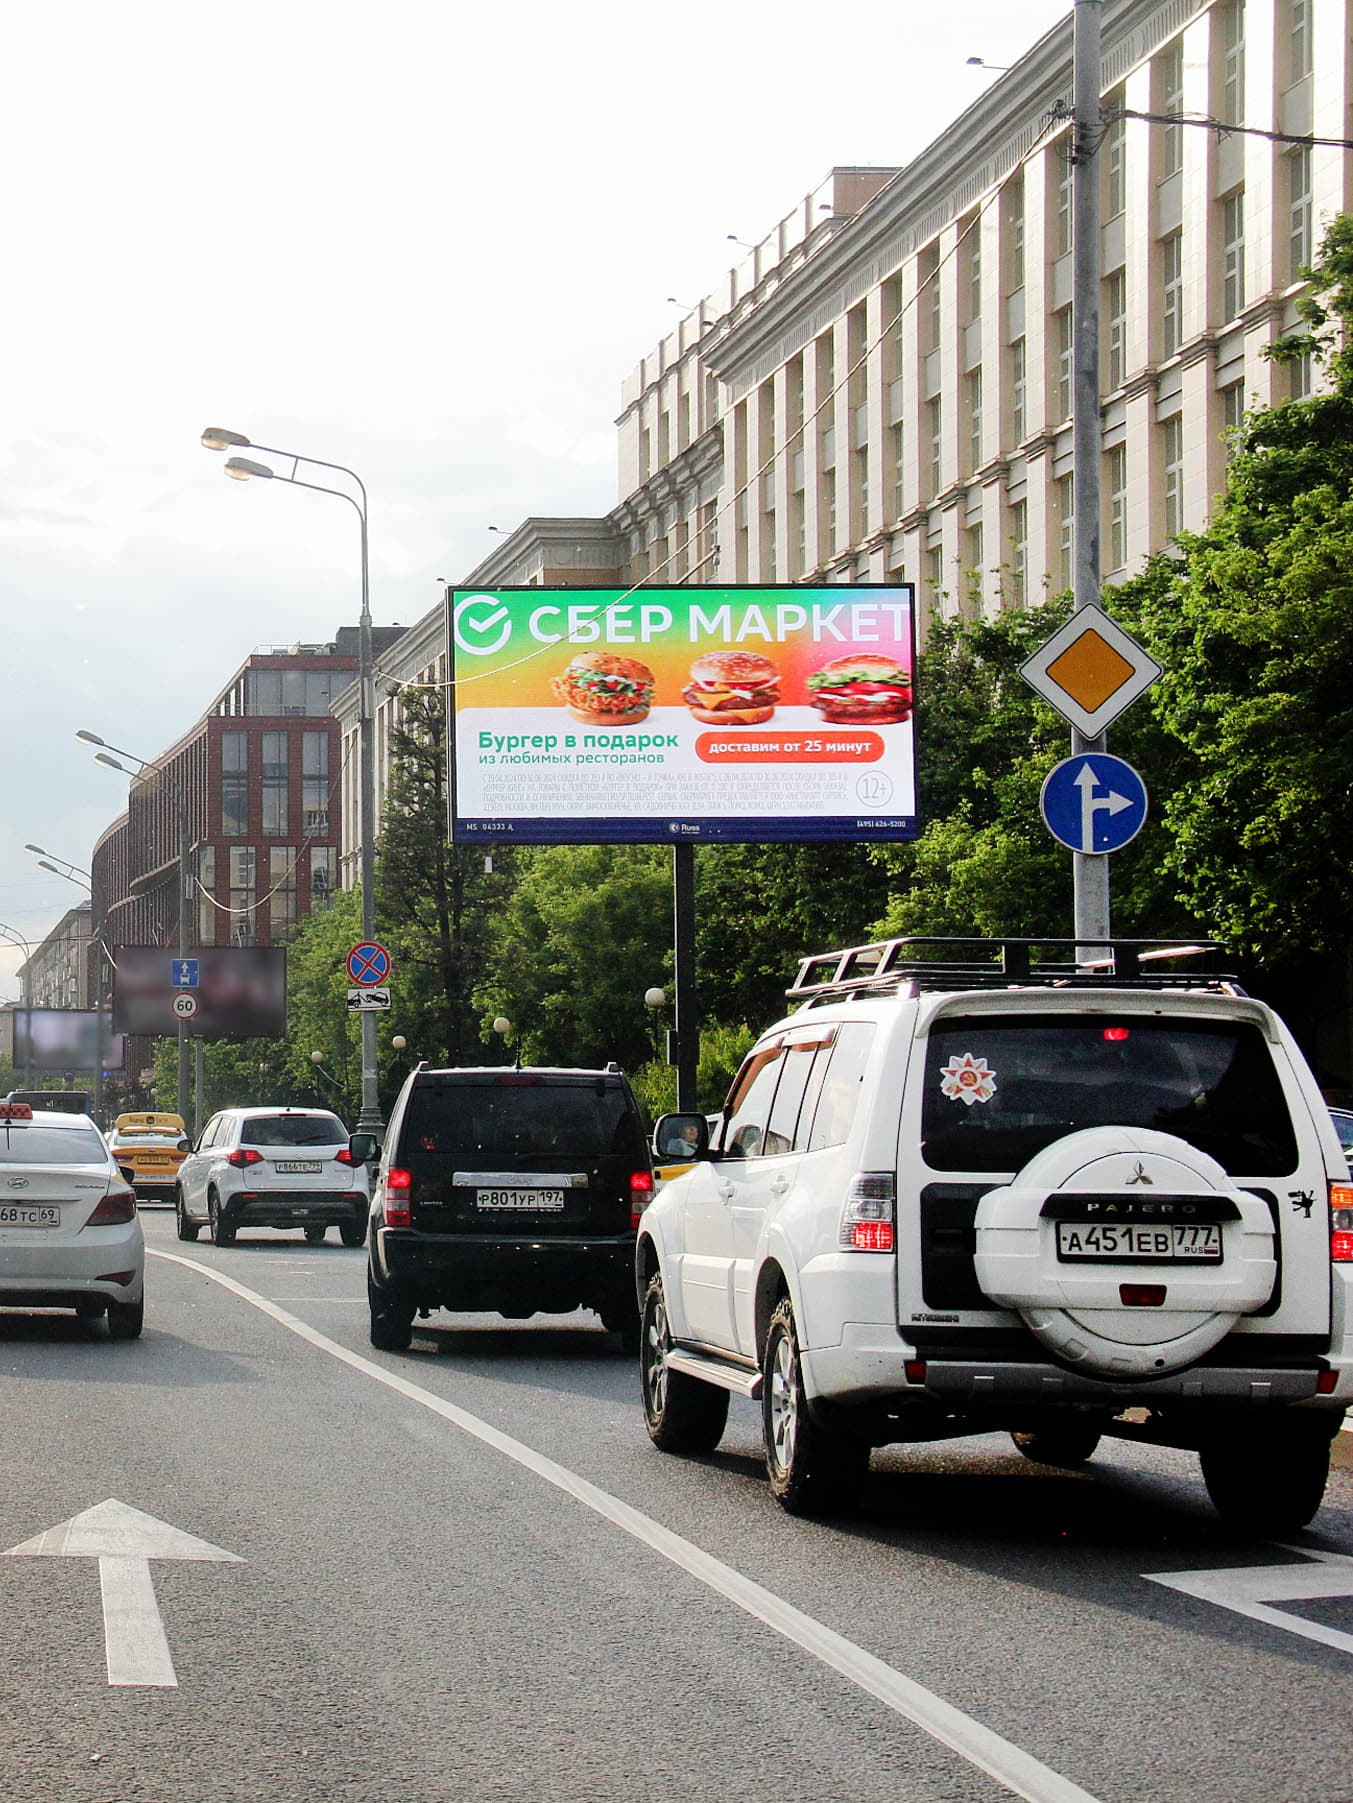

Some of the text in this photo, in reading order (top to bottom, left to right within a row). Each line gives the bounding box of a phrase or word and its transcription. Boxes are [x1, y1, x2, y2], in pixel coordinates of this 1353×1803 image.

[528, 603, 910, 643] СБЕР МАРКЕТ
[478, 731, 679, 753] Бургер в подарок
[708, 740, 872, 755] доставим от 25 минут
[479, 750, 665, 766] из любимых ресторанов
[177, 1000, 193, 1011] 60
[540, 1191, 560, 1202] 197
[40, 1209, 55, 1220] 69
[1087, 1203, 1197, 1214] PAJERO
[1067, 1226, 1213, 1253] А451ЕВ 777
[1184, 1246, 1204, 1254] RUS
